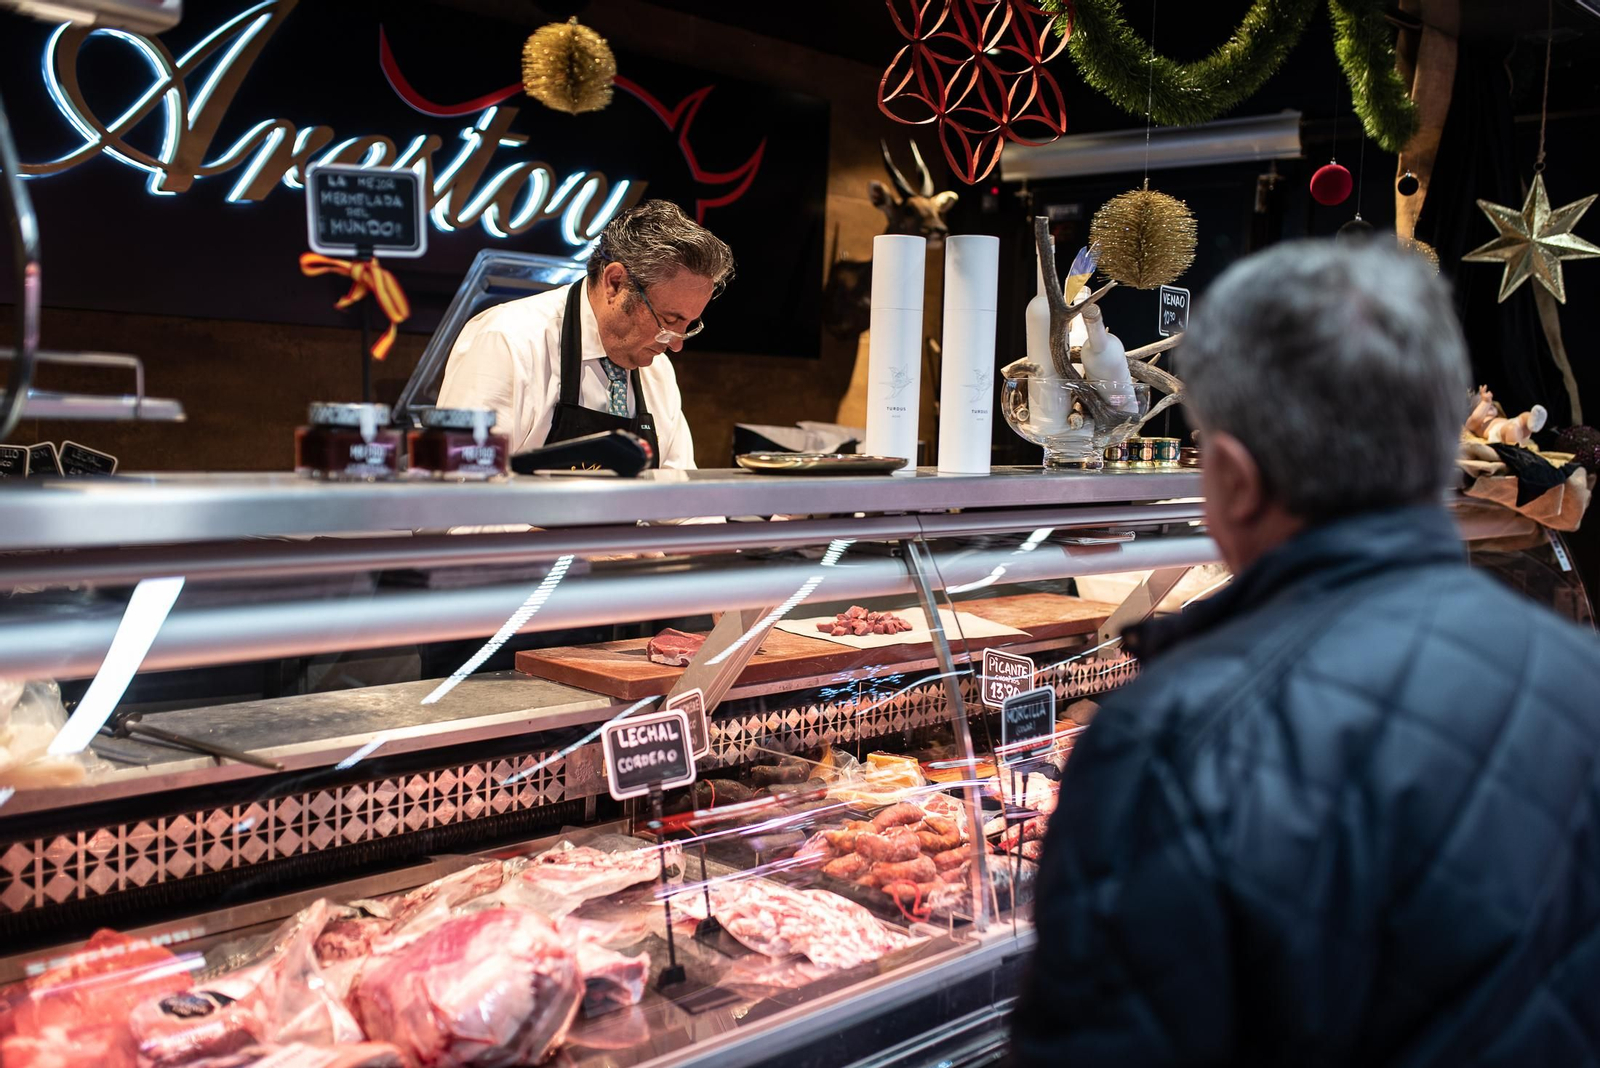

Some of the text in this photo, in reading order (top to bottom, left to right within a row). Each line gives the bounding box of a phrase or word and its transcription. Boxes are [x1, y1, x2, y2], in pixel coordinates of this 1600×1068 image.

[328, 175, 395, 190] LA MEJOR
[320, 191, 403, 208] MERMELADA
[1163, 292, 1185, 308] VENAO
[1006, 700, 1046, 724] MORCILLA
[617, 722, 679, 748] LECHAL
